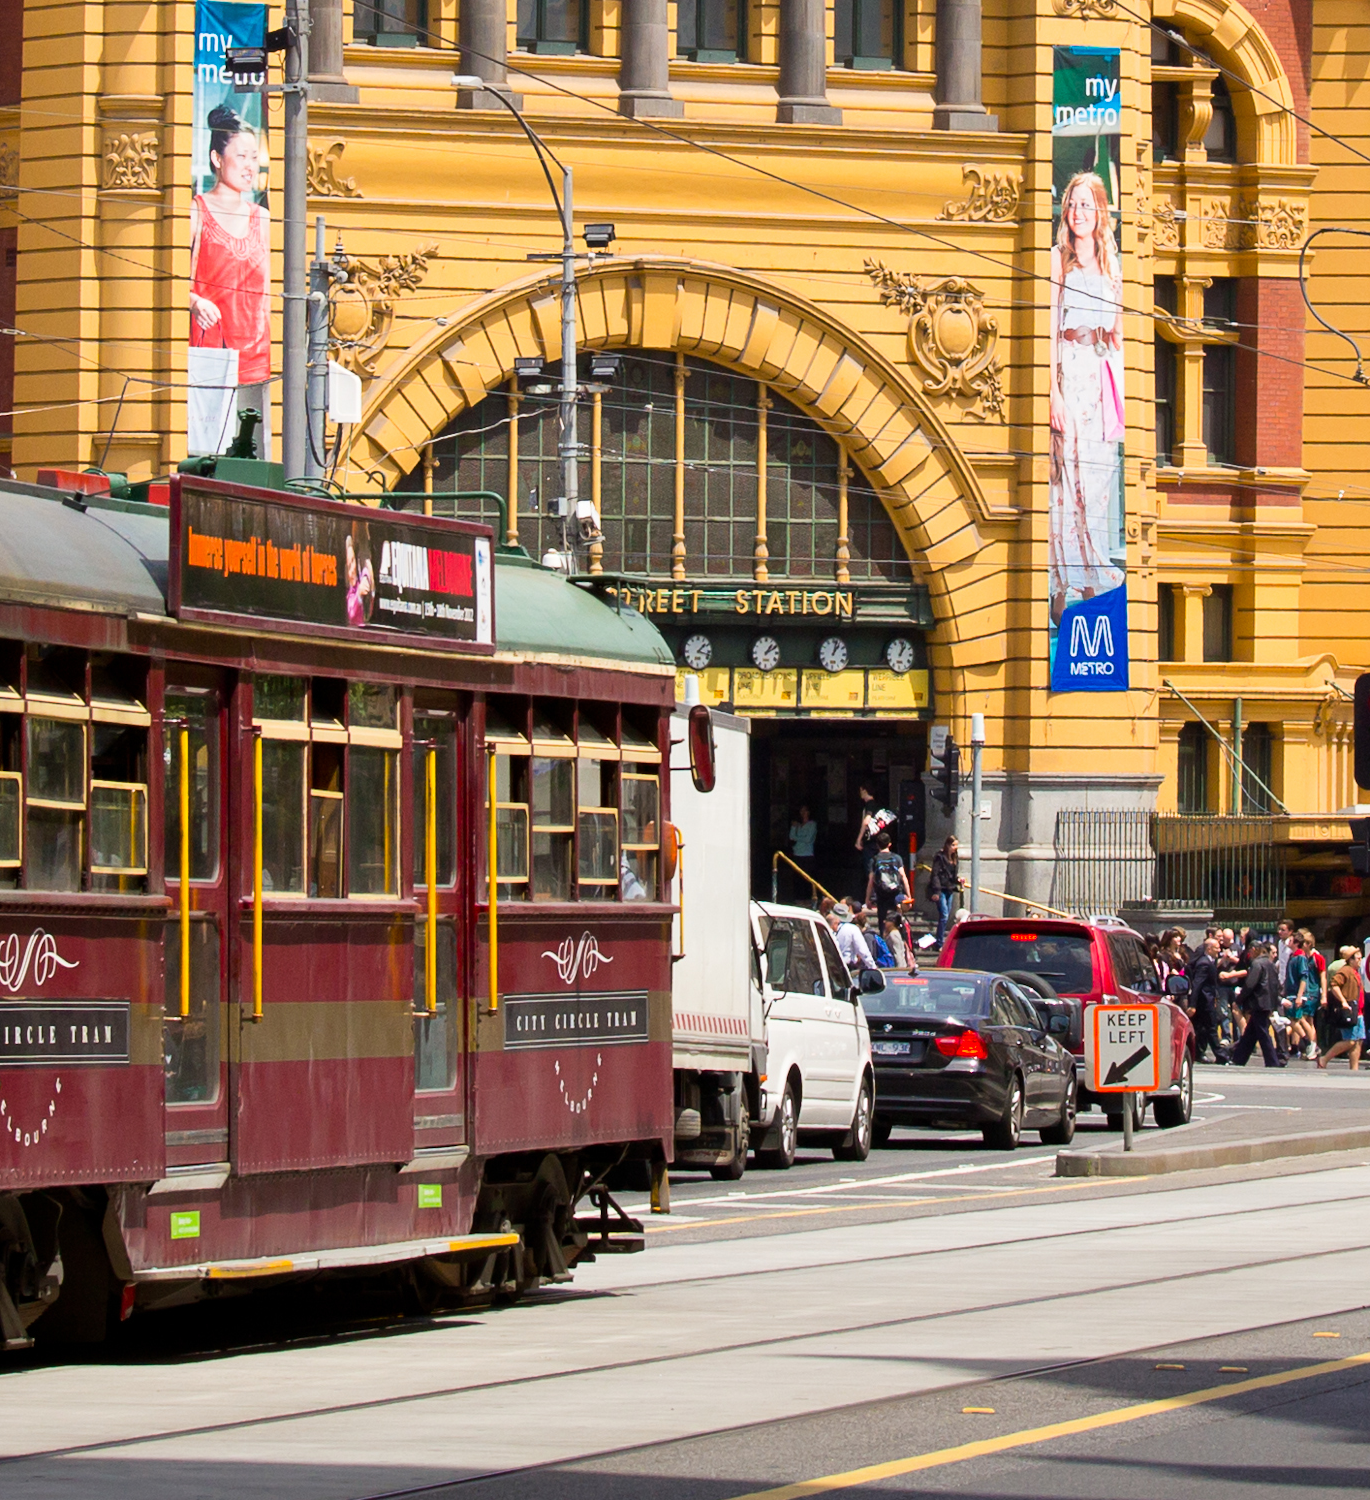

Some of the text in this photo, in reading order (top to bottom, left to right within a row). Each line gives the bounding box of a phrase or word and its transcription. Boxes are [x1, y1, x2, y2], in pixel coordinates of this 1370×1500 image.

[198, 32, 233, 60] my
[1085, 77, 1118, 103] my
[1055, 103, 1118, 127] metro
[735, 588, 854, 616] STATION
[1070, 661, 1115, 676] METRO
[871, 683, 886, 692] LINE
[516, 1011, 638, 1032] CITY CIRCLE TRAM
[1107, 1013, 1147, 1027] KEEP
[70, 1025, 112, 1044] TRAM
[1109, 1030, 1146, 1043] LEFT
